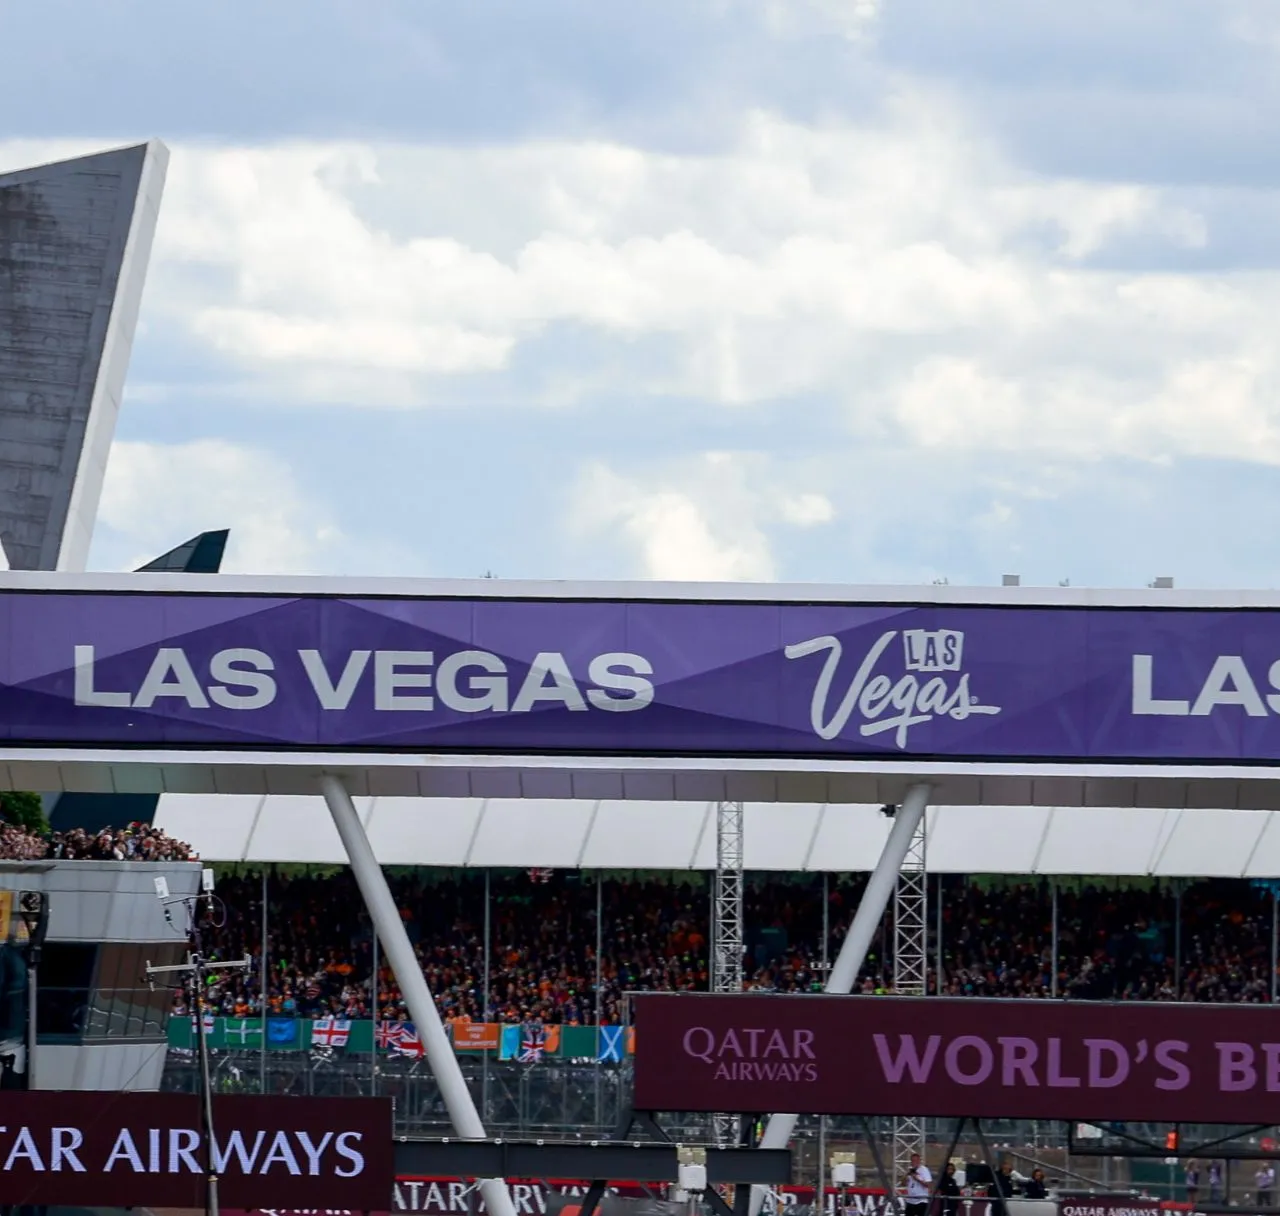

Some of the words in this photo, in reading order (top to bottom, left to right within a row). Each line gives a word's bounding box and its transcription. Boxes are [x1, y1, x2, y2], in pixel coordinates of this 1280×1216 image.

[903, 629, 964, 672] LAS
[74, 645, 278, 708] LAS
[300, 649, 656, 713] VEGAS
[682, 1025, 818, 1066] QATAR
[873, 1033, 1191, 1093] WORLD'S
[714, 1062, 819, 1083] AIRWAYS
[103, 1126, 367, 1178] AIRWAYS
[391, 1181, 470, 1212] ATAR
